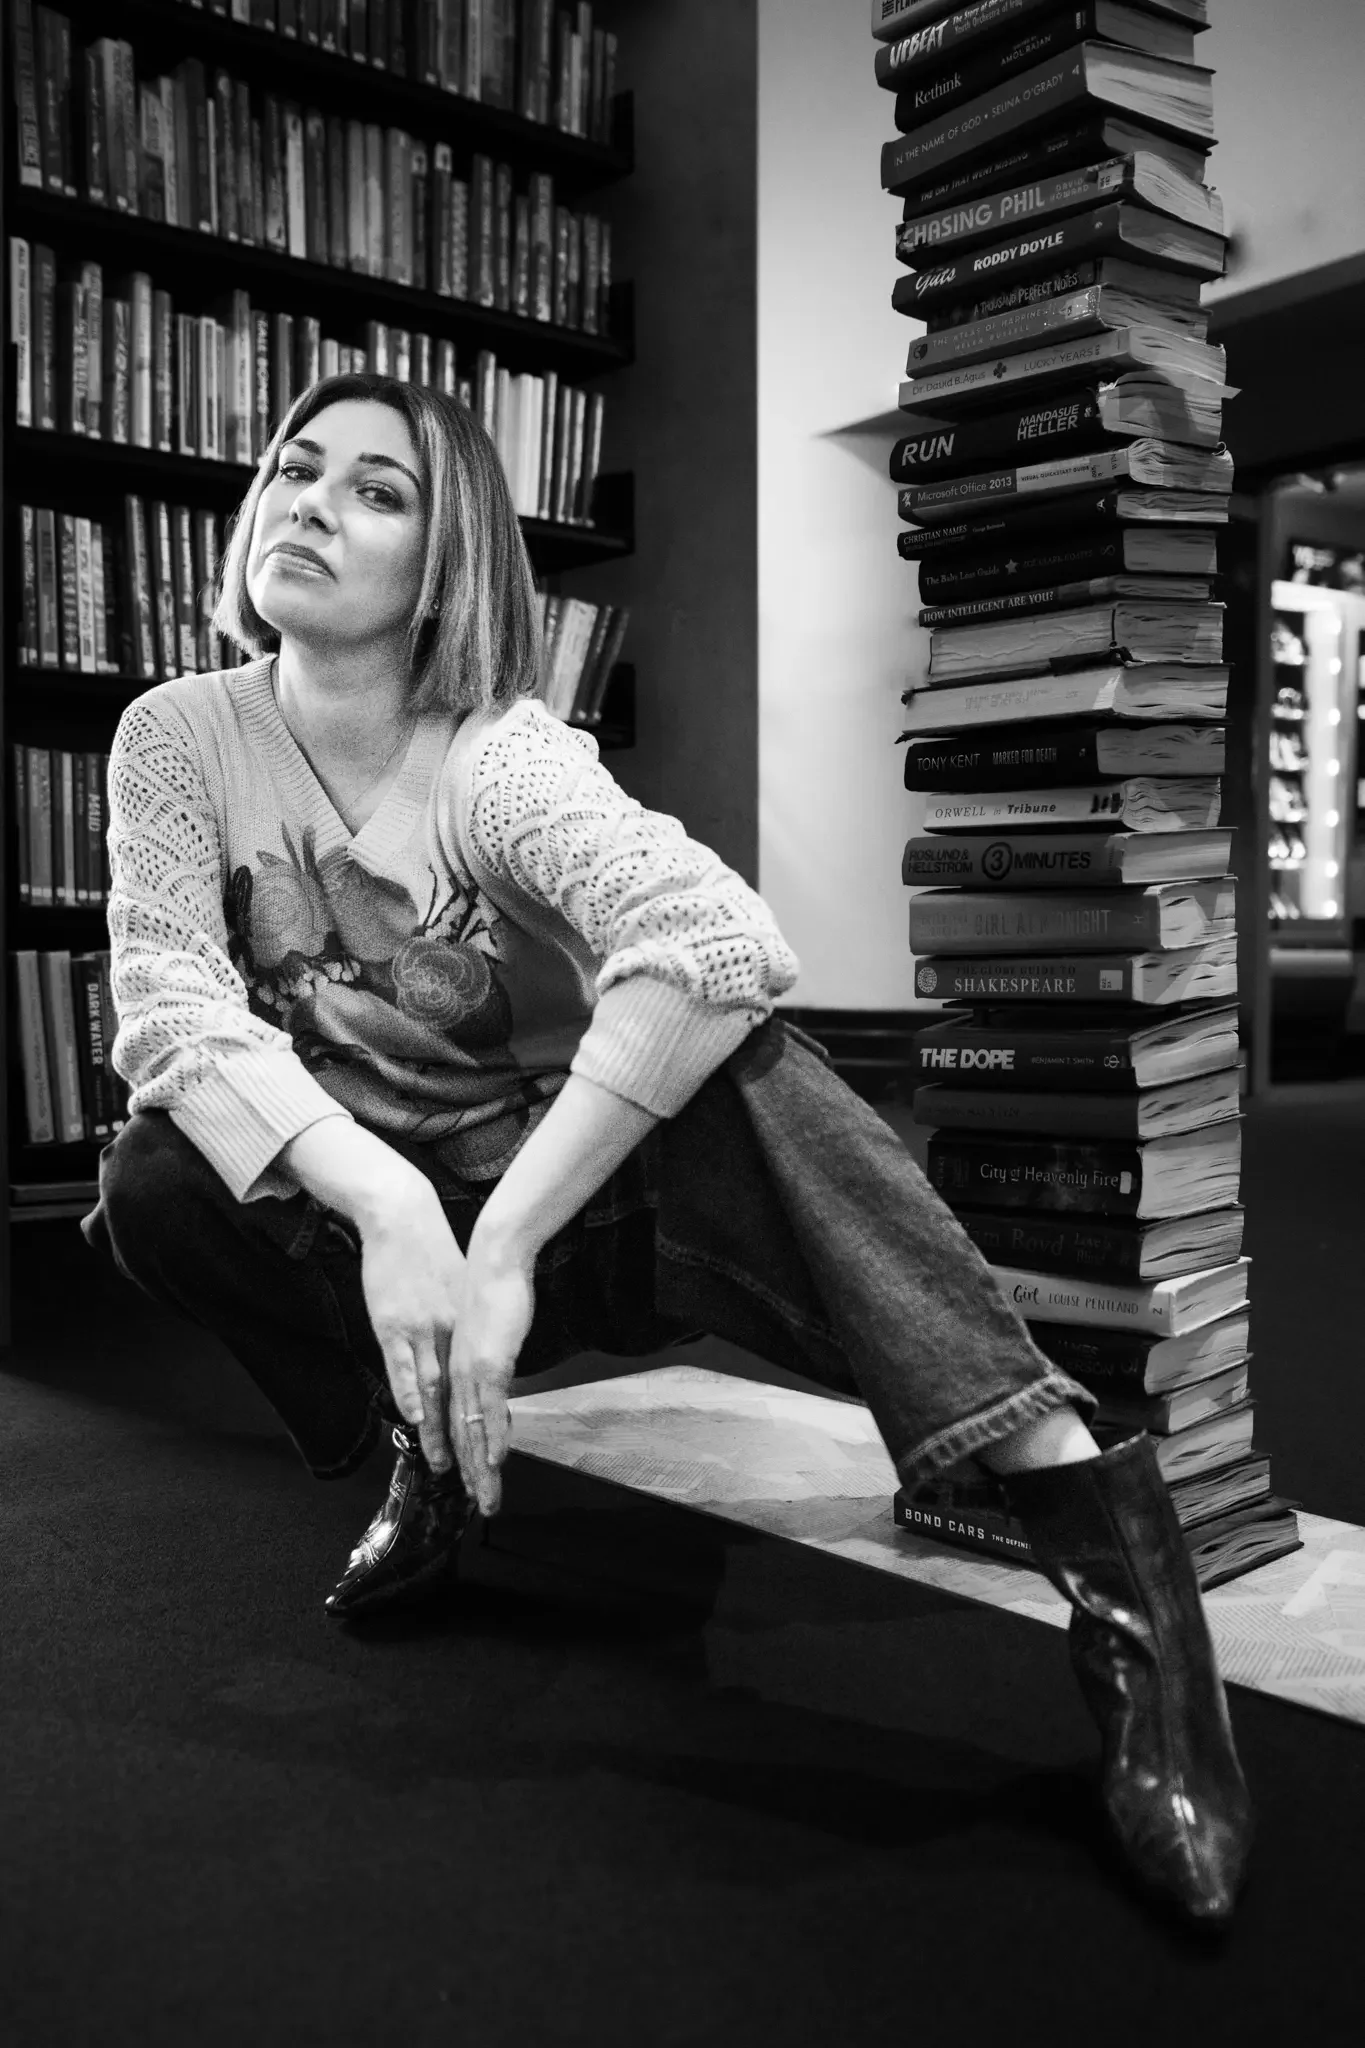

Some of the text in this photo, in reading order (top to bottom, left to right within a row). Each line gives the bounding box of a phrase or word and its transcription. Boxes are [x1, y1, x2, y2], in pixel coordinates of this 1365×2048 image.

[889, 18, 949, 69] UPBEAT
[1001, 34, 1052, 66] AMOL RAJAN
[914, 72, 962, 108] Rethink
[904, 143, 921, 161] THE
[920, 133, 945, 155] NAME
[947, 124, 960, 140] OF
[960, 115, 983, 135] GOD
[991, 95, 1021, 118] SELINA
[1022, 72, 1065, 101] O'GRADY
[903, 186, 1046, 249] CHASING PHIL
[973, 231, 1065, 272] RODDY DOYLE
[915, 265, 957, 300] Guts
[1018, 280, 1053, 304] PERFECT
[932, 336, 949, 348] THE
[1024, 356, 1058, 372] LUCKY
[1059, 347, 1094, 364] YEARS
[912, 384, 925, 396] Dr.
[1016, 415, 1079, 441] HELLER
[1018, 403, 1081, 428] MANDASUE
[901, 432, 956, 467] RUN
[1020, 472, 1040, 483] VISUAL
[1073, 464, 1090, 474] GUIDE
[917, 475, 1014, 503] Microsoft Office 2013
[903, 531, 943, 546] CHRISTIAN
[942, 524, 968, 539] NAMES
[925, 574, 940, 588] The
[940, 572, 958, 586] Baby
[976, 564, 1001, 577] Guide
[923, 590, 1055, 624] HOW INTELLIGENT ARE YOU?
[916, 752, 982, 772] TONY KENT
[992, 746, 1058, 766] MARKED FOR DEATH
[87, 793, 102, 833] MAID
[934, 805, 988, 820] ORWELL
[1006, 802, 1057, 816] Tribune
[909, 849, 969, 862] ROSLUND &
[990, 850, 1004, 872] 3
[1014, 851, 1092, 870] MINUTES
[975, 912, 1011, 937] GIRL
[953, 977, 1077, 994] SHAKESPEARE
[87, 982, 102, 1019] DARK
[89, 1020, 104, 1067] WATER
[919, 1047, 957, 1069] THE
[958, 1048, 1016, 1070] DOPE
[979, 1162, 1008, 1185] City
[1008, 1167, 1022, 1183] of
[1024, 1165, 1089, 1192] Heavenly
[1092, 1168, 1121, 1189] Fire
[1012, 1284, 1041, 1306] Girl
[1048, 1292, 1080, 1308] LOUISE
[1085, 1295, 1140, 1316] PENTLAND
[904, 1507, 942, 1529] BOND
[948, 1519, 985, 1541] CARS
[991, 1533, 1004, 1544] THE
